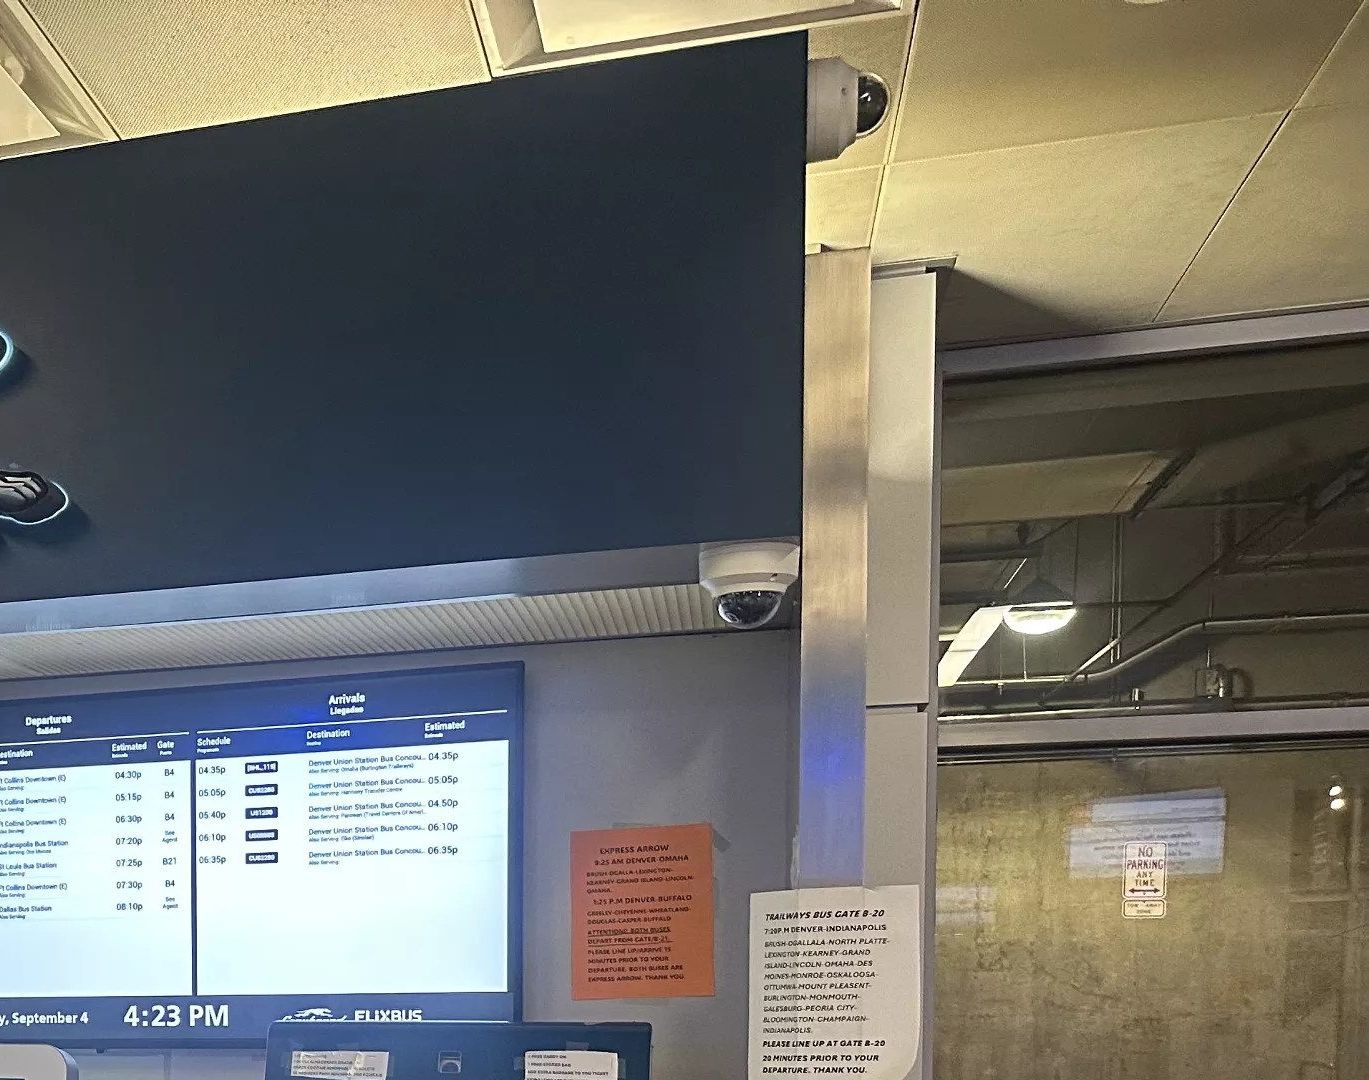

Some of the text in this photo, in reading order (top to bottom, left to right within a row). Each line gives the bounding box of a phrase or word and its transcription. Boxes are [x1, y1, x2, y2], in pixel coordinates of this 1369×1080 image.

[329, 693, 365, 705] Arrivals
[25, 715, 72, 726] Departures
[425, 721, 465, 731] Estimated
[307, 729, 350, 739] Destination
[157, 741, 174, 749] Gate
[197, 737, 231, 746] Schedule
[112, 742, 147, 751] Estimated
[309, 759, 332, 767] Denver
[355, 756, 379, 764] Station
[198, 766, 226, 774] 04:35p
[115, 771, 142, 779] 04:30p
[116, 793, 142, 801] 05:15p
[199, 789, 226, 797] 05:05p
[116, 815, 142, 823] 06:30p
[199, 811, 226, 819] 05:40p
[116, 838, 142, 846] 07:20p
[199, 834, 226, 842] 06:10p
[1138, 847, 1152, 857] NO
[116, 859, 143, 867] 07:25p
[199, 856, 226, 864] 06:35p
[1127, 859, 1163, 869] PARKING
[116, 881, 143, 889] 07:30p
[116, 903, 143, 911] 08:10p
[766, 912, 811, 921] TRAILWAYS
[813, 911, 832, 919] BUS
[835, 910, 860, 918] GATE
[12, 1012, 78, 1027] September
[80, 1012, 89, 1024] 4
[124, 1005, 229, 1027] 4:23 PM
